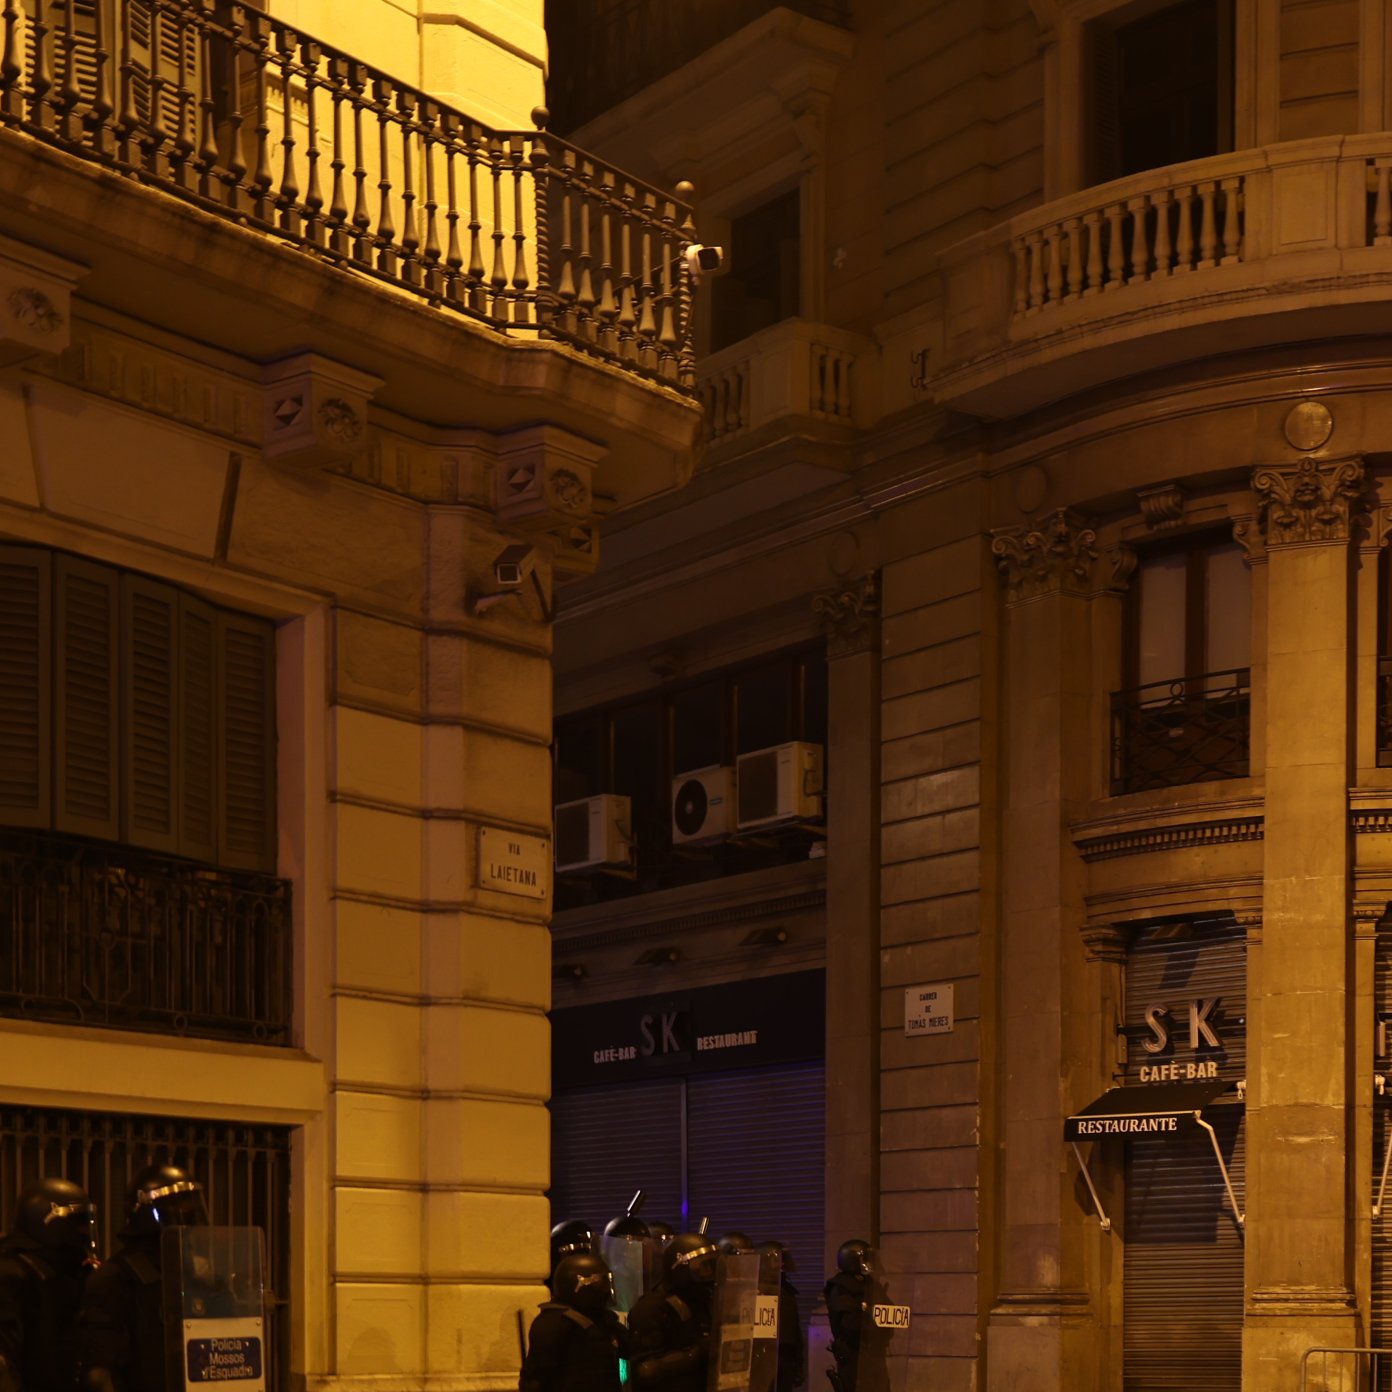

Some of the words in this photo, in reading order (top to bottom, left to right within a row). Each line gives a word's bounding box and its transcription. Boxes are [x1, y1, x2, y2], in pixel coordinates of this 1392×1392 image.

[508, 843, 520, 855] VIA
[490, 863, 536, 887] LAIETANA
[696, 1030, 758, 1050] RESTAURANT
[1077, 1117, 1178, 1134] RESTAURANTE
[209, 1352, 245, 1365] Mossos
